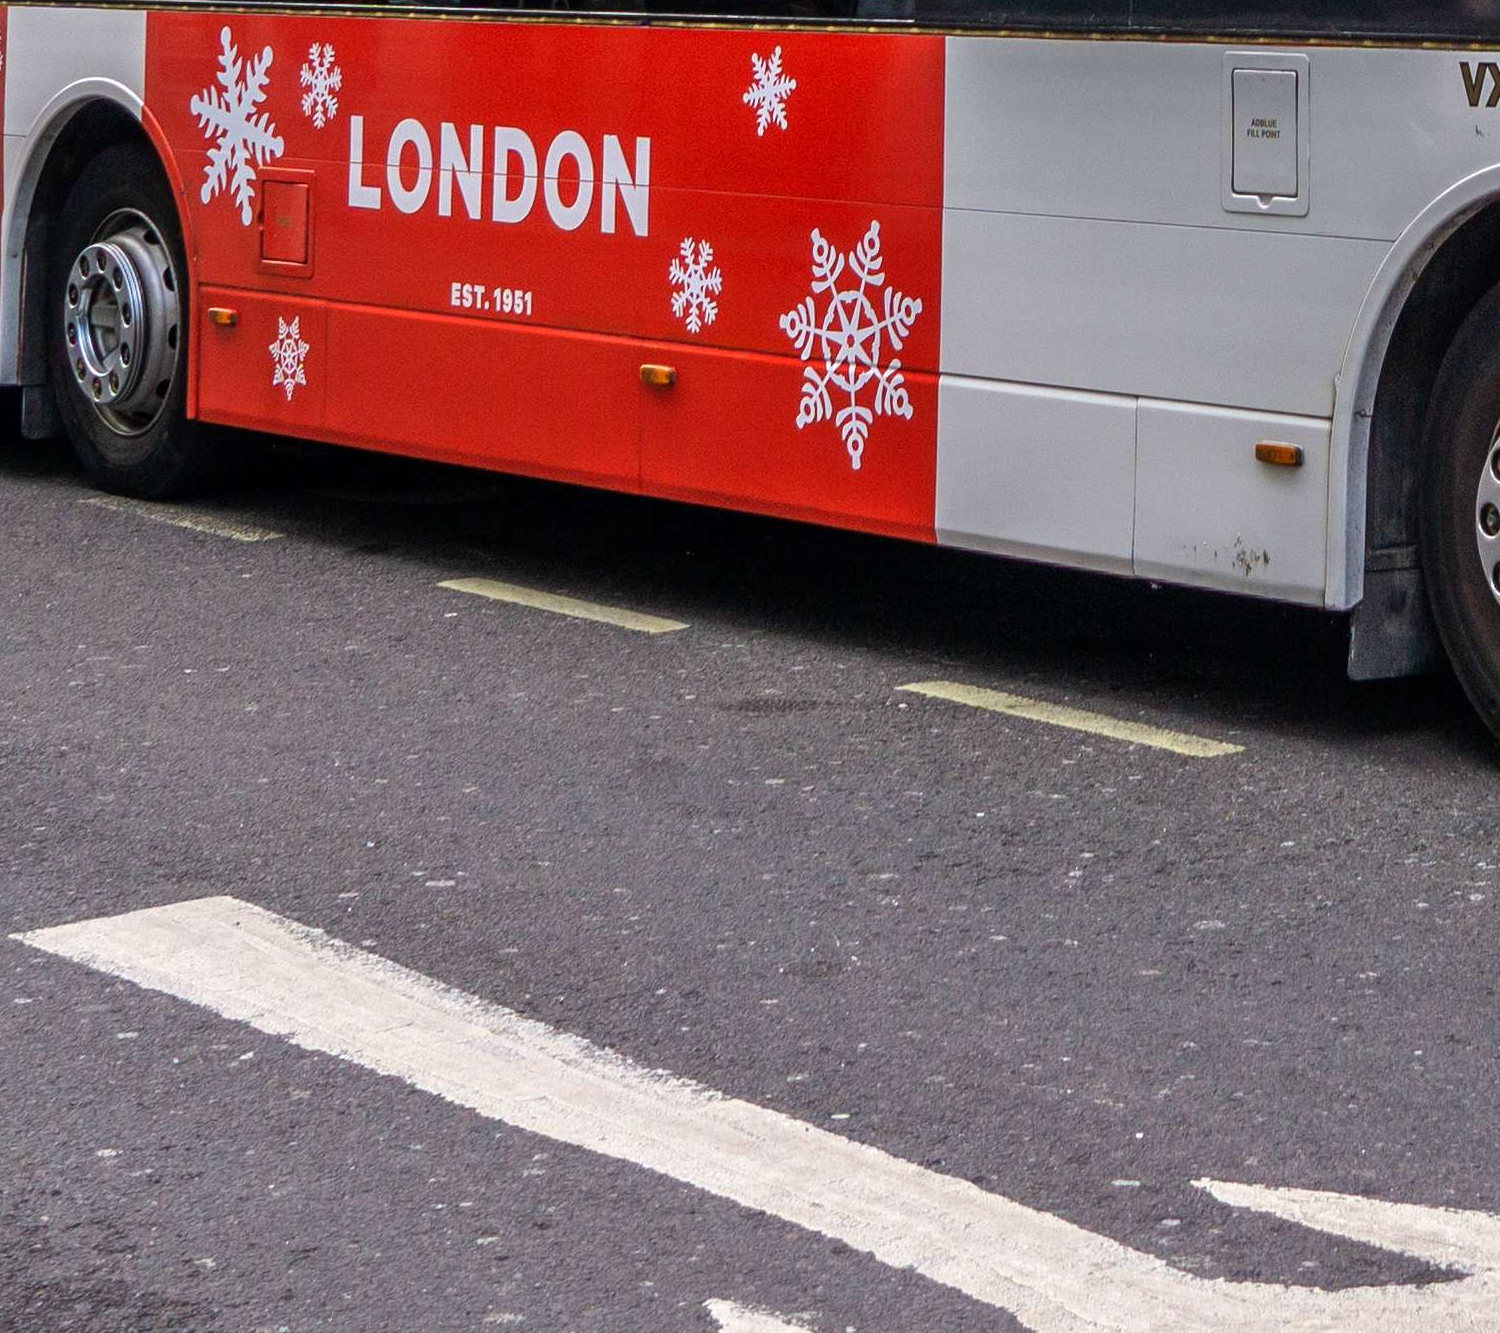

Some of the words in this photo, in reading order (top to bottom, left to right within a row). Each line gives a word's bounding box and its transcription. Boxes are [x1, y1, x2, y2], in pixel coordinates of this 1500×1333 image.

[1246, 128, 1260, 138] FILL
[1261, 129, 1281, 139] POINT
[348, 115, 650, 238] LONDON
[450, 281, 492, 314] EST.
[493, 286, 534, 317] 1951
